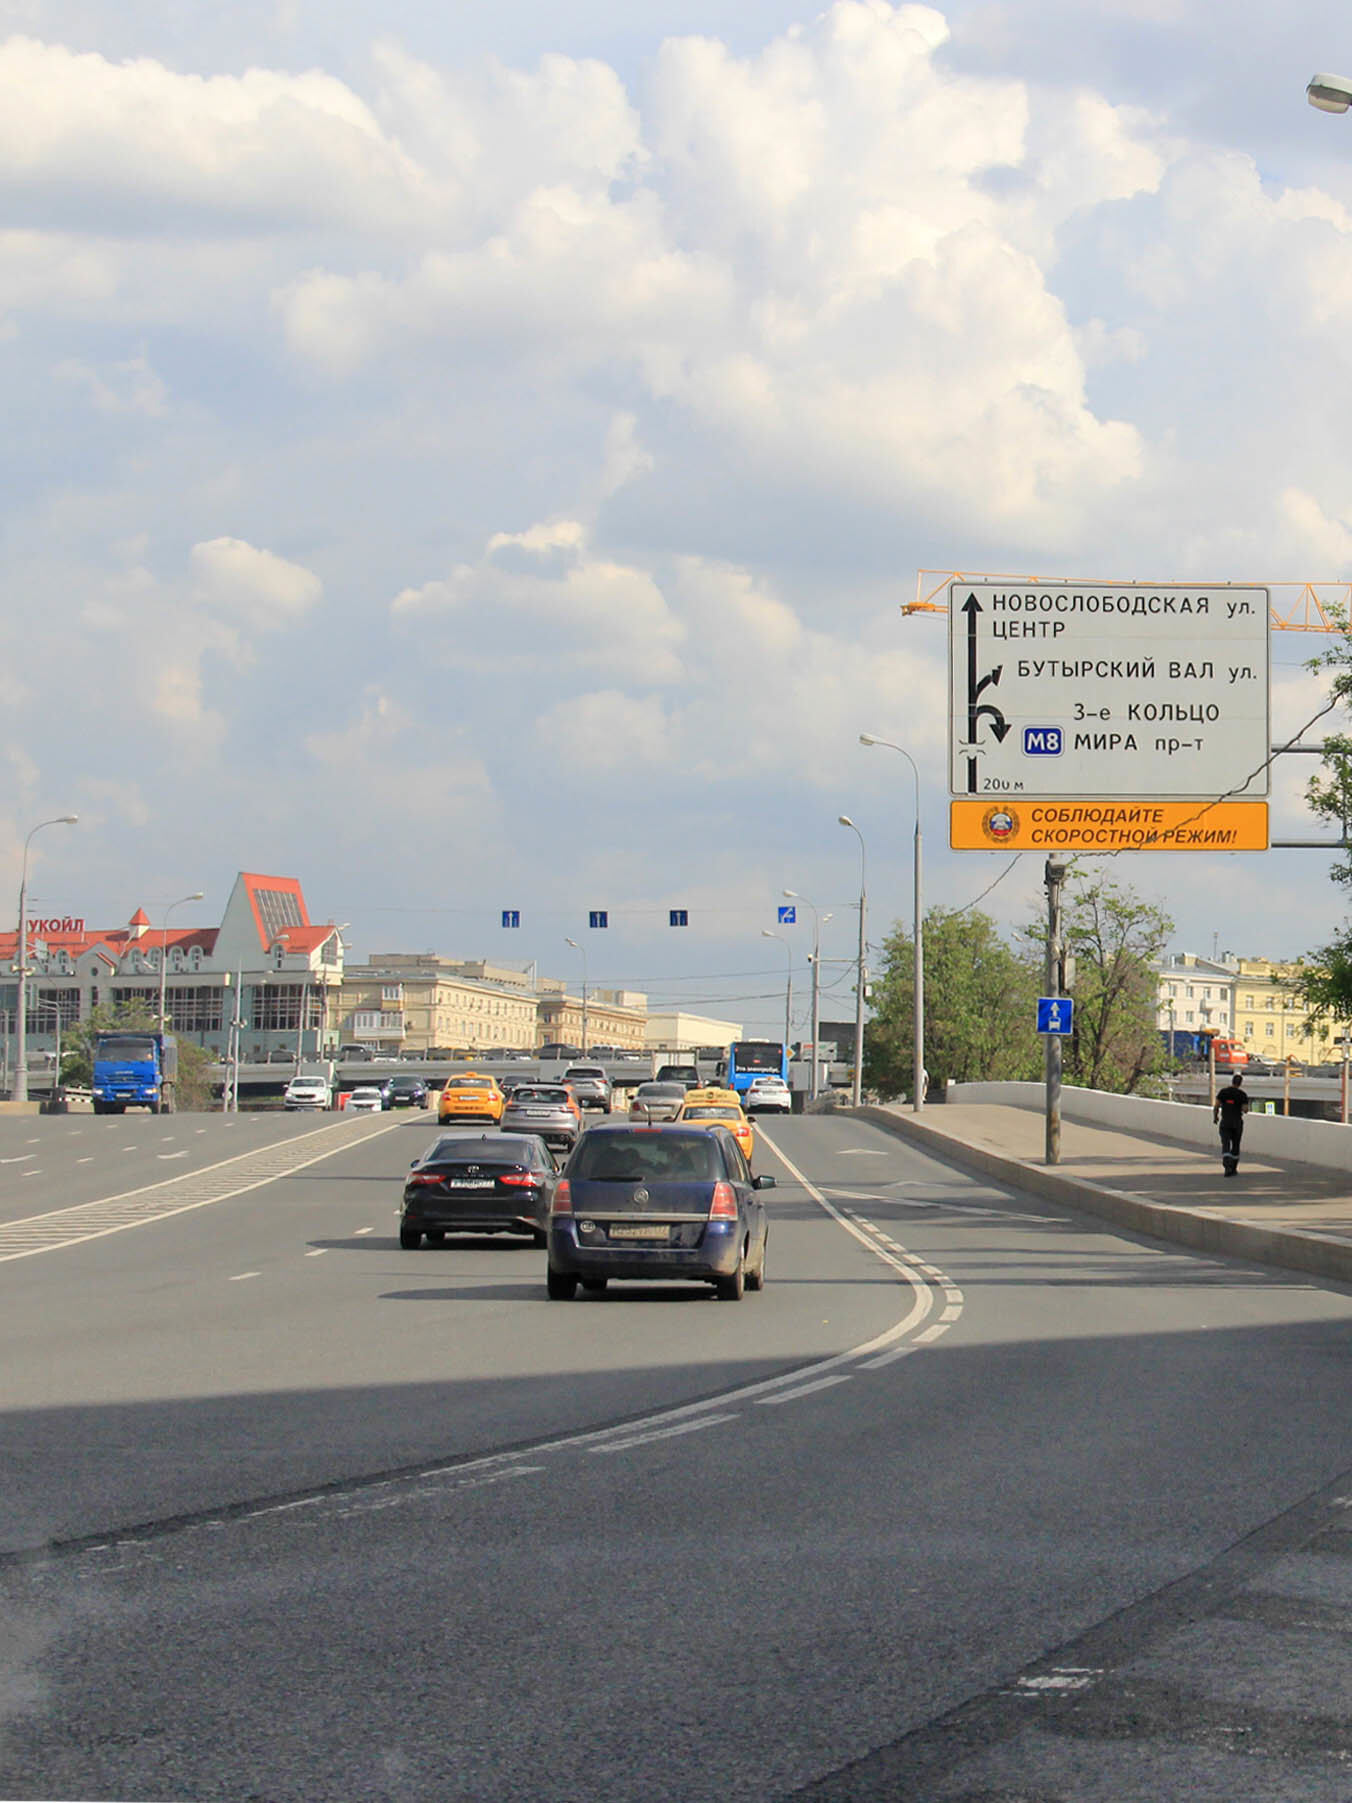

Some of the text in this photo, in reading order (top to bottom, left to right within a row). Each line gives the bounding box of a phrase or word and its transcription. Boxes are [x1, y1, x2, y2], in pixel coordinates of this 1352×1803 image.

[993, 594, 1256, 618] НОВОСЛОБОДСКАЯ ул.
[993, 621, 1065, 640] ЦЕНТР
[1018, 657, 1257, 684] БУТЫРСКИЙ ВАЛ ул.
[1073, 703, 1220, 724] 3-е КОЛЬЦО
[1026, 733, 1060, 752] М8
[1074, 734, 1204, 756] МИРА пр-т
[1031, 808, 1164, 825] СОБЛЮДАЙТЕ
[1031, 827, 1237, 844] СКОРОСТНОЙ РЕЖИМ!
[20, 914, 84, 932] УКОЙЛ
